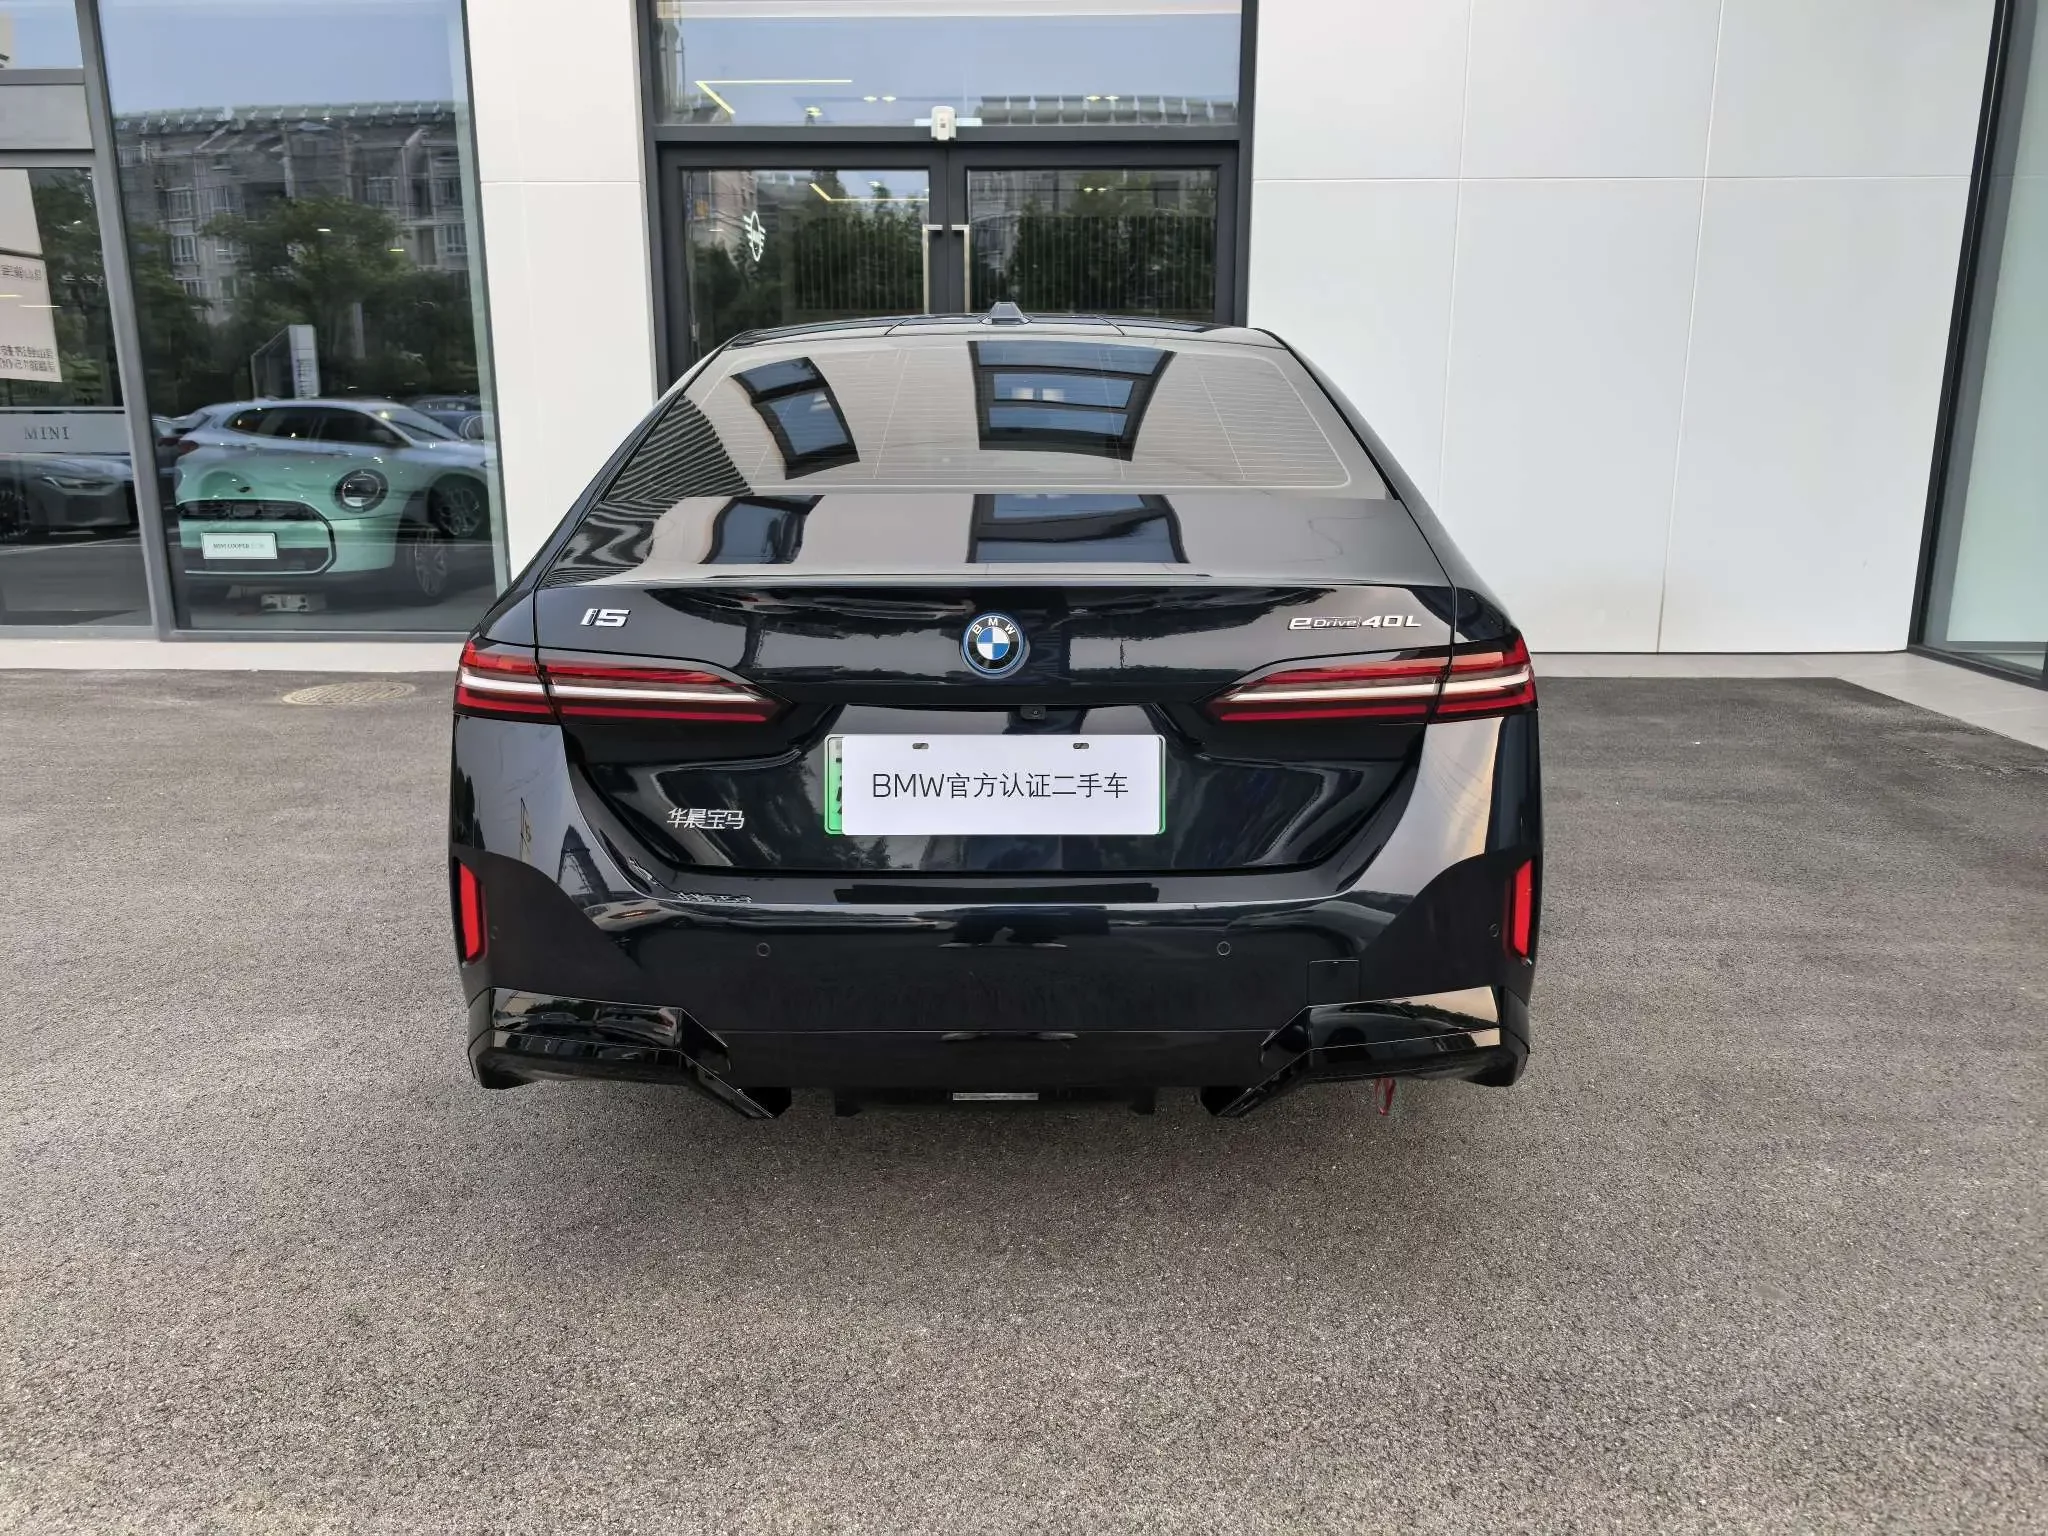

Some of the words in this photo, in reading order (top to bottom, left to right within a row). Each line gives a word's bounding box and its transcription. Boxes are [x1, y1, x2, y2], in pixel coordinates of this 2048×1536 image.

[24, 426, 70, 440] MINI
[872, 772, 1129, 799] BMW官方认证二手车
[667, 808, 745, 829] 华晨宝马
